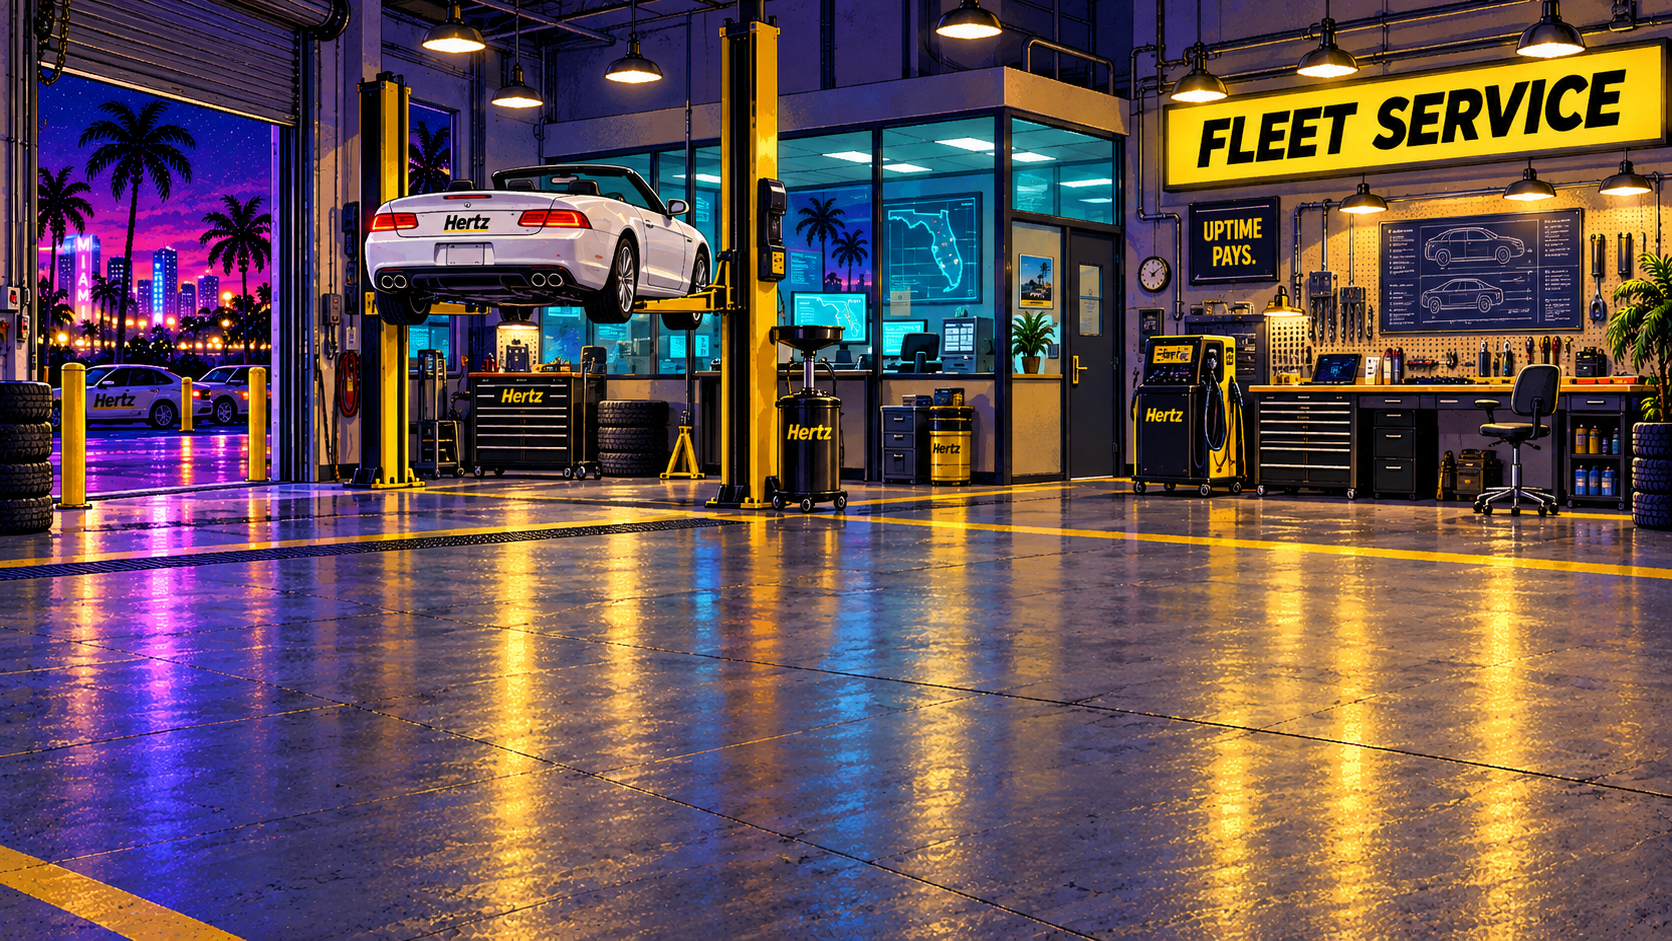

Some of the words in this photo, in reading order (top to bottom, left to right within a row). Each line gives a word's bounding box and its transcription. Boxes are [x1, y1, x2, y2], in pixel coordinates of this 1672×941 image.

[1197, 102, 1357, 168] FLEET
[1373, 69, 1626, 150] SERVICE
[444, 214, 490, 231] Hertz
[1204, 218, 1263, 242] UPTIME
[1213, 245, 1257, 267] PAYS.
[77, 237, 90, 320] MIAMI
[95, 393, 135, 408] Hertz
[502, 388, 543, 403] Hertz
[1146, 408, 1183, 422] Hertz
[788, 424, 832, 440] Hertz
[933, 443, 960, 454] Hertz
